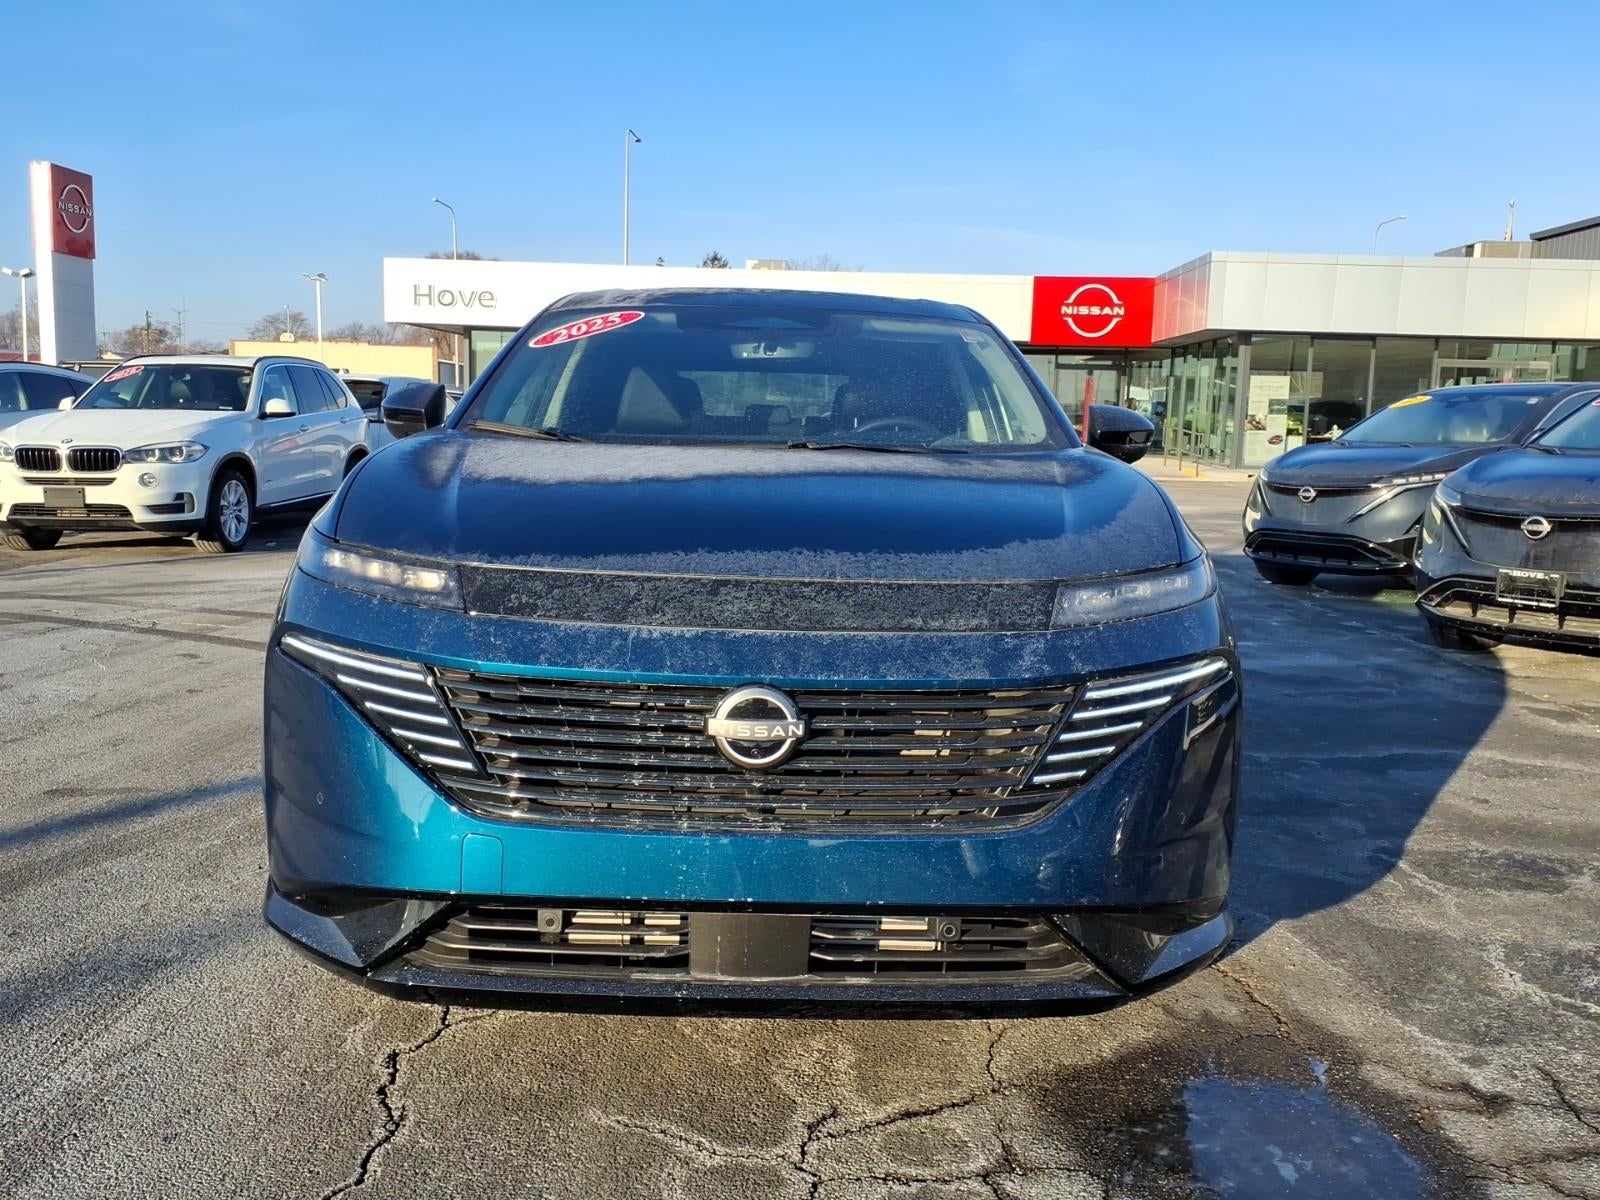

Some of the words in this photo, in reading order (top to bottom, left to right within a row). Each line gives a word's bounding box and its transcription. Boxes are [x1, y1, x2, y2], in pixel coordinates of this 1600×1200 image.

[58, 201, 92, 217] NISSAN
[413, 284, 496, 308] Hove
[1060, 305, 1125, 316] NISSAN
[552, 312, 622, 343] 2025
[711, 723, 803, 738] NISSAN
